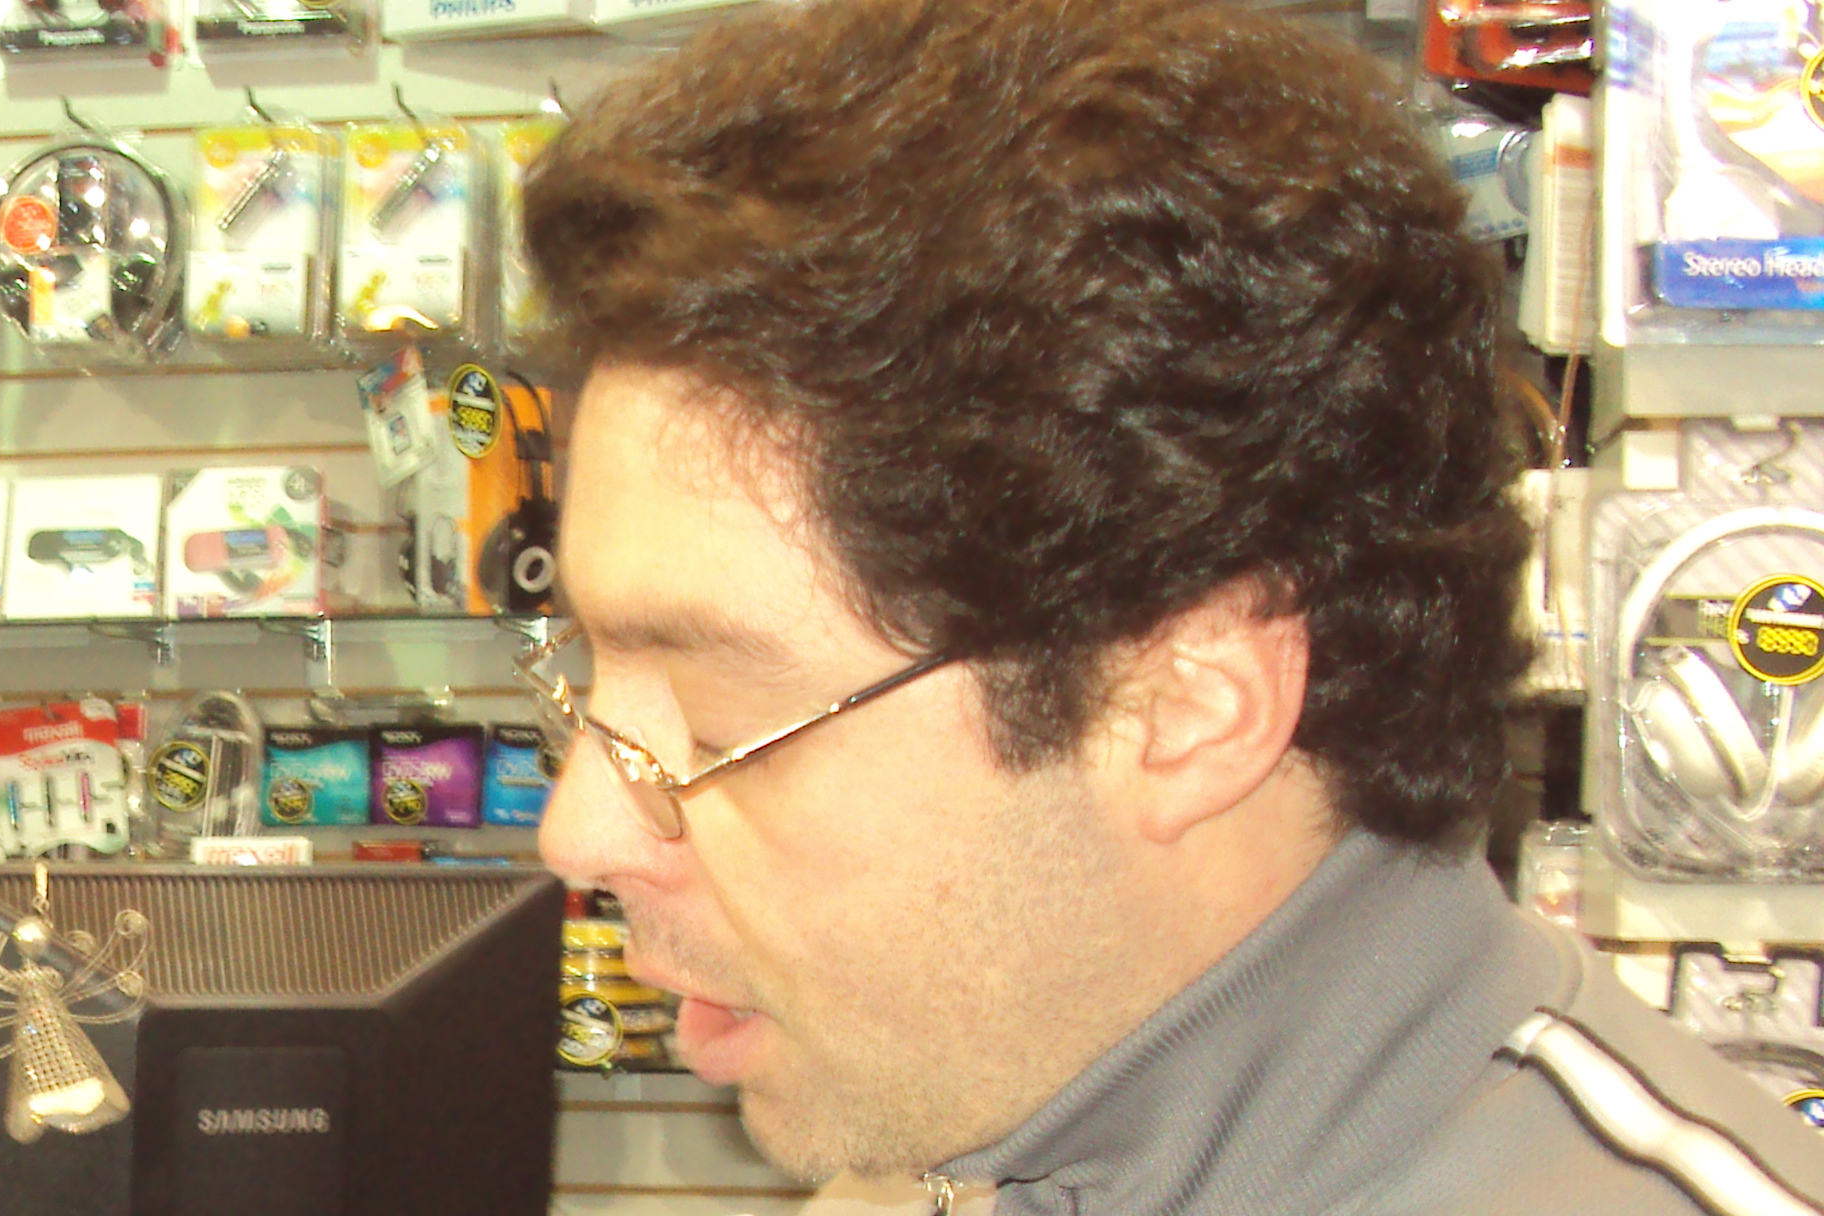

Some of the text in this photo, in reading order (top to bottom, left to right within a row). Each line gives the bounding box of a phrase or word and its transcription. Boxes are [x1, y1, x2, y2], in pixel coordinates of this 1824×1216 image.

[1682, 251, 1761, 277] Stereo
[381, 730, 424, 745] SONY
[197, 1107, 331, 1136] SAMSUNG
